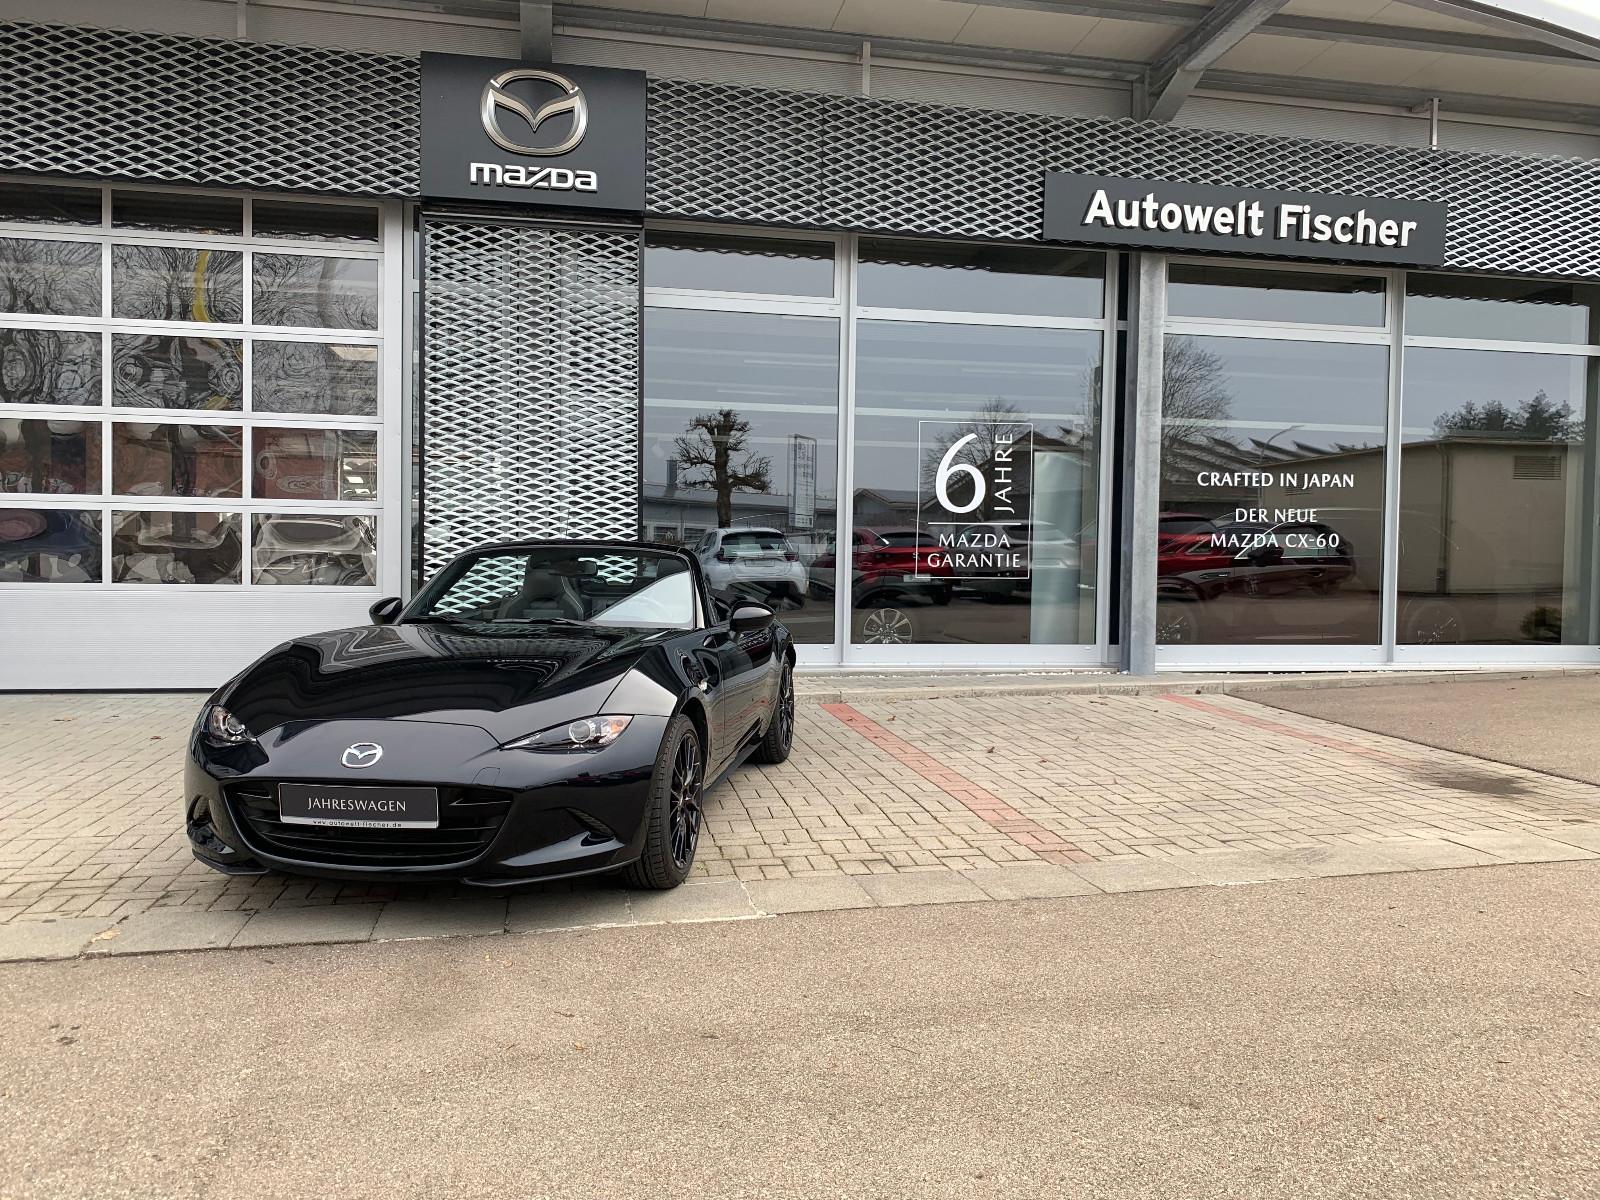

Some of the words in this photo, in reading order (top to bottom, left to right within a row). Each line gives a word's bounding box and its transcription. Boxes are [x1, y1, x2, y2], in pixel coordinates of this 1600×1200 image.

[1084, 189, 1264, 236] Autowelt
[1278, 203, 1417, 247] Fischer
[935, 432, 986, 514] 6
[994, 433, 1015, 513] JAHRE
[1197, 472, 1274, 487] CRAFTED
[1279, 473, 1298, 487] IN
[1302, 473, 1354, 490] JAPAN
[1235, 508, 1268, 523] DER
[1274, 508, 1318, 523] NEUE
[939, 533, 1010, 548] MAZDA
[1210, 533, 1279, 548] MAZDA
[1285, 533, 1340, 548] CX-60
[927, 553, 1020, 568] GARANTIE
[307, 797, 407, 812] JAHRESWAGEN
